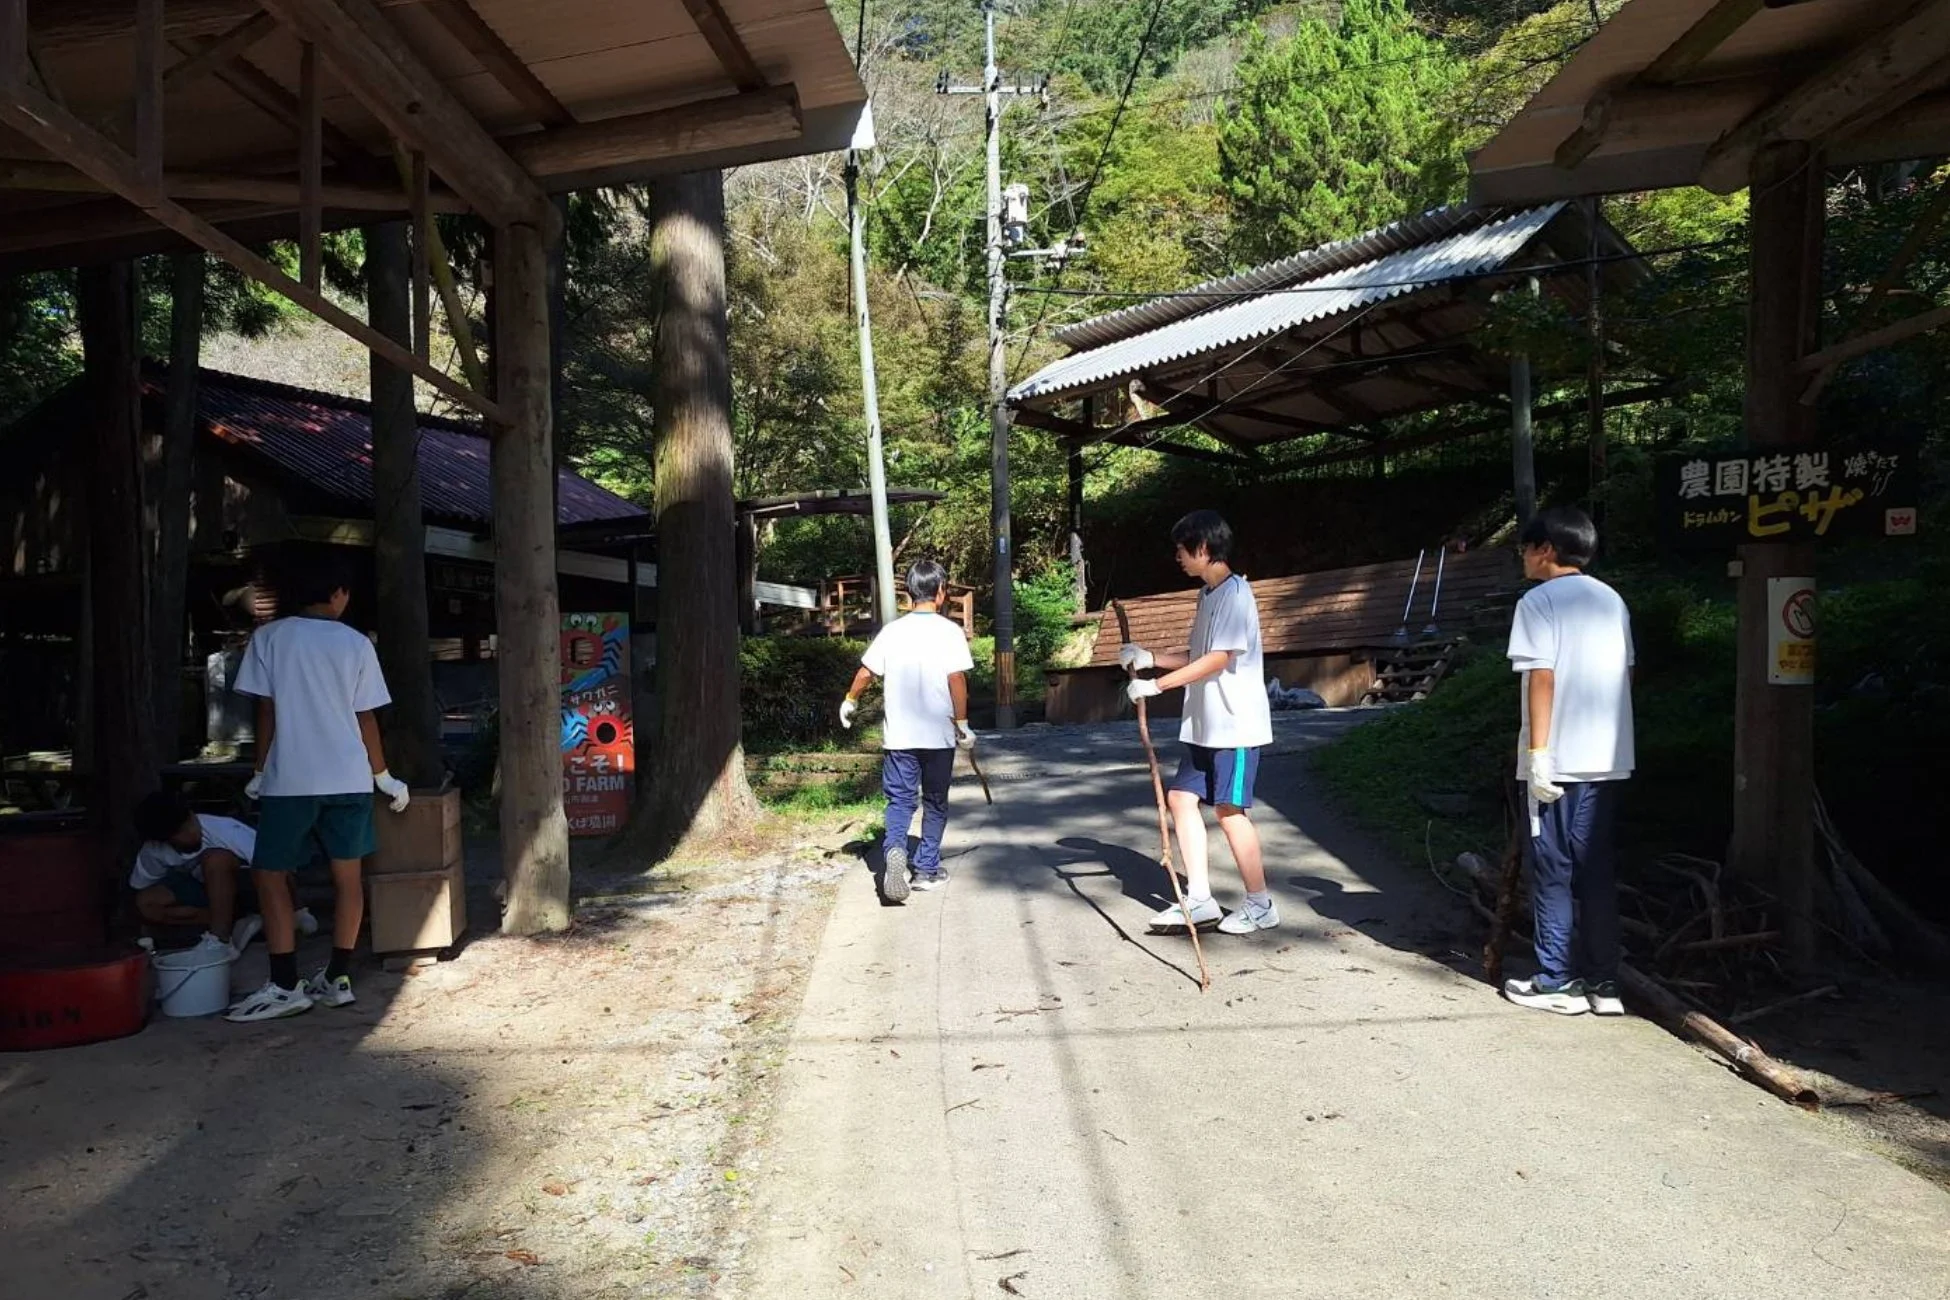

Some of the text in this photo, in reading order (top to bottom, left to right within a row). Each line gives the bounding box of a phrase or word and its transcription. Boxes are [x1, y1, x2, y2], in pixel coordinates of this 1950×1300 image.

[1678, 452, 1830, 499] 農園特製
[1683, 508, 1743, 528] ドラムカン
[1748, 485, 1864, 537] ピザ
[570, 684, 619, 705] サワガニ
[576, 775, 625, 793] FARM
